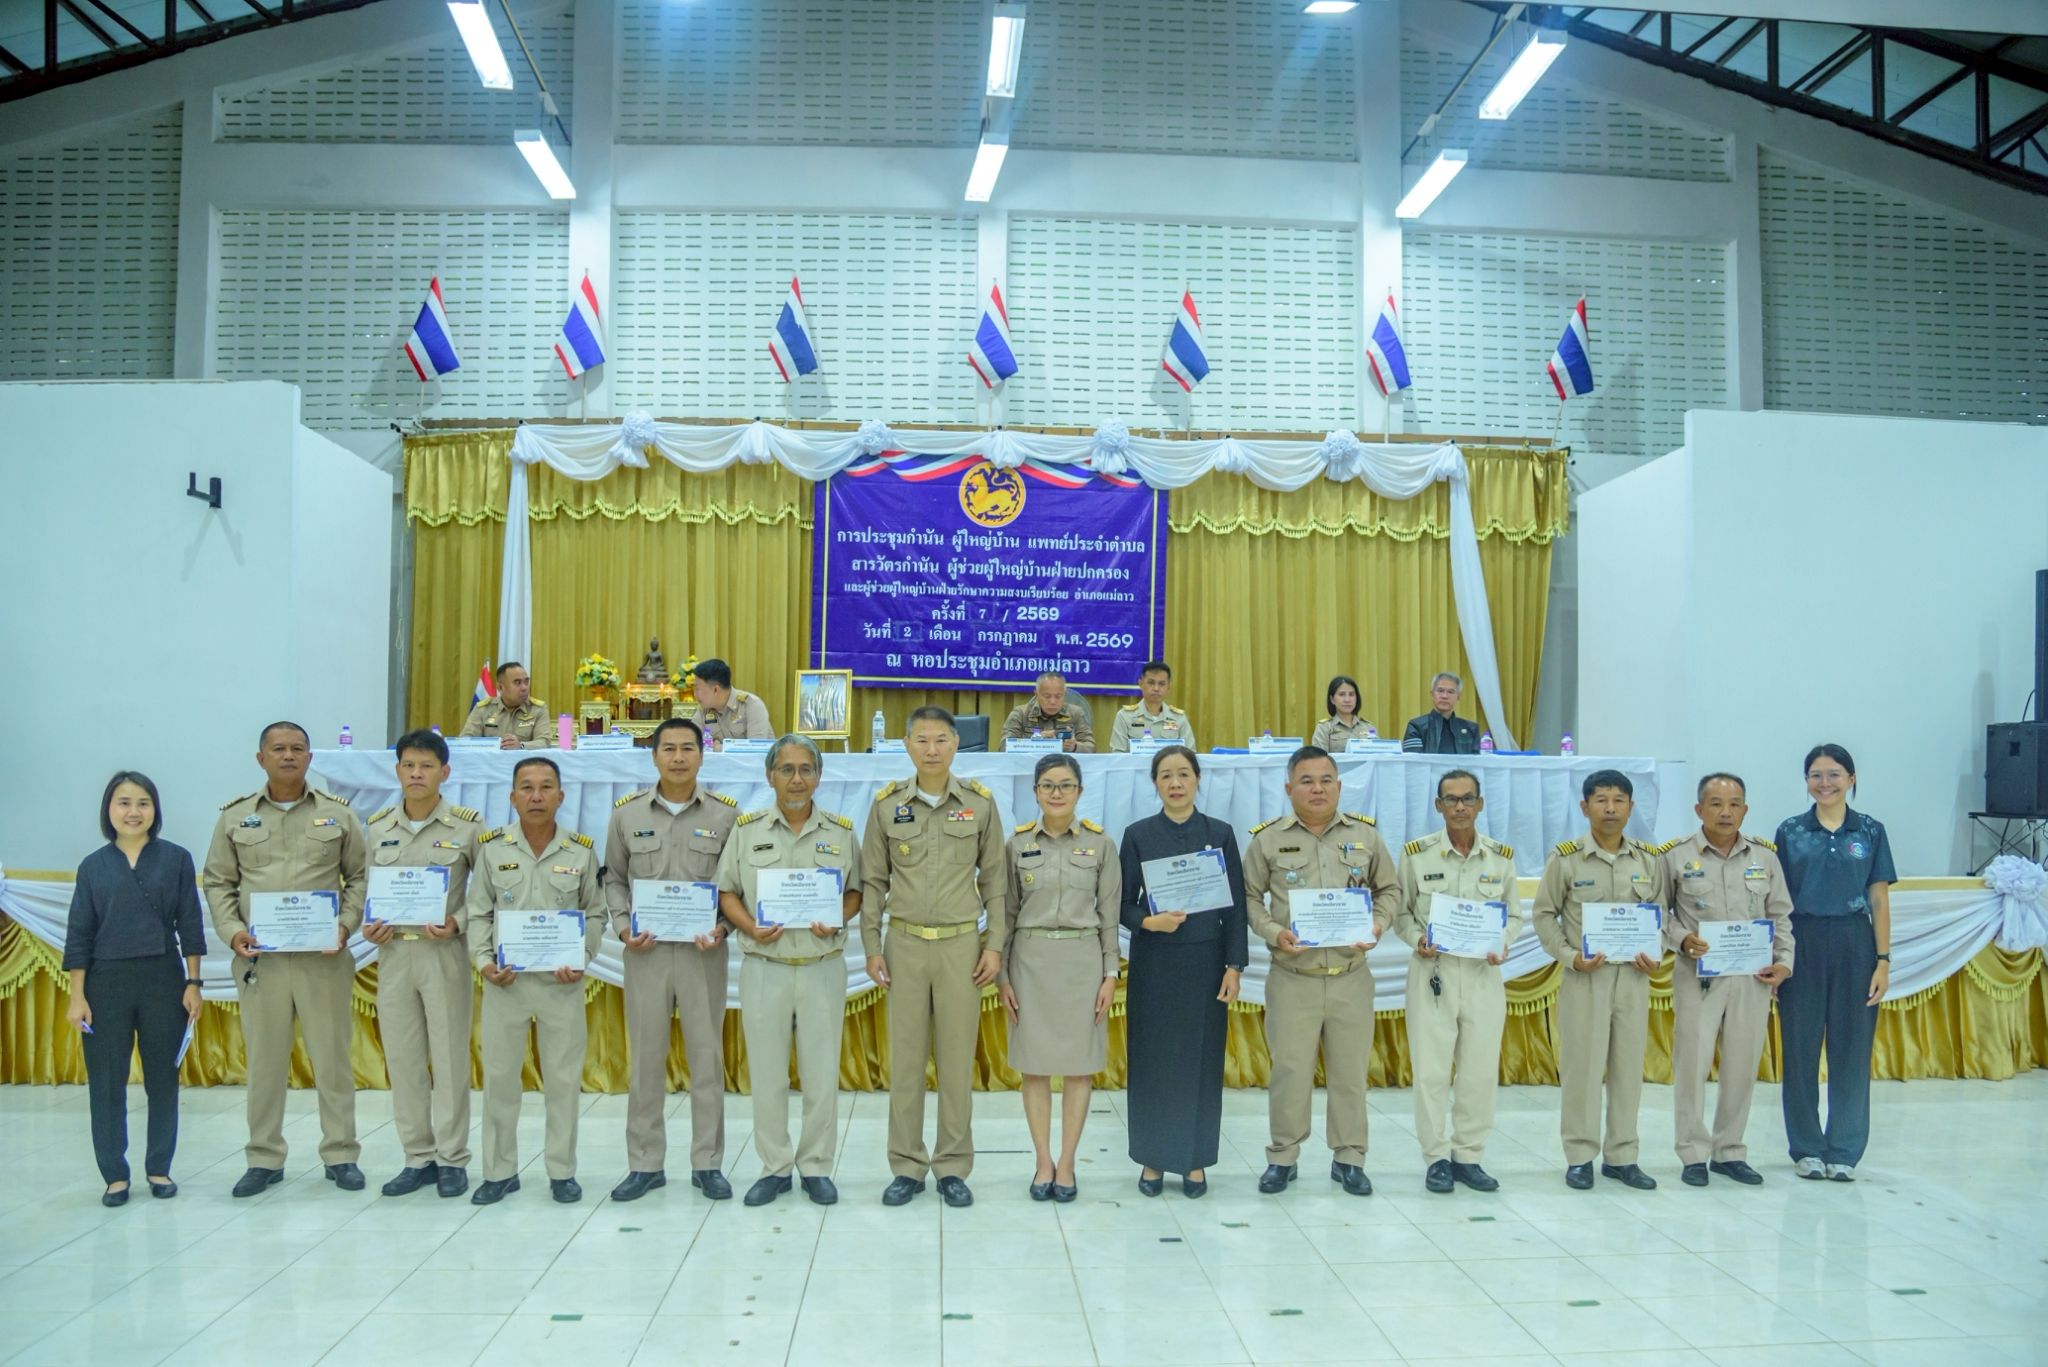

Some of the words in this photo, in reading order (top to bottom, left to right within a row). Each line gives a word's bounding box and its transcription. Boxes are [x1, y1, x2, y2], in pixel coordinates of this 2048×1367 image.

[932, 600, 966, 621] ครั้งที่
[979, 609, 985, 619] 7
[1002, 609, 1008, 623] /
[1017, 607, 1060, 621] 2569
[863, 618, 891, 640] วันที่
[904, 627, 912, 637] 2
[929, 626, 961, 641] เดือน
[978, 630, 1037, 650] กรกฎาคม
[1086, 633, 1133, 648] 2569
[886, 653, 901, 668] ณ
